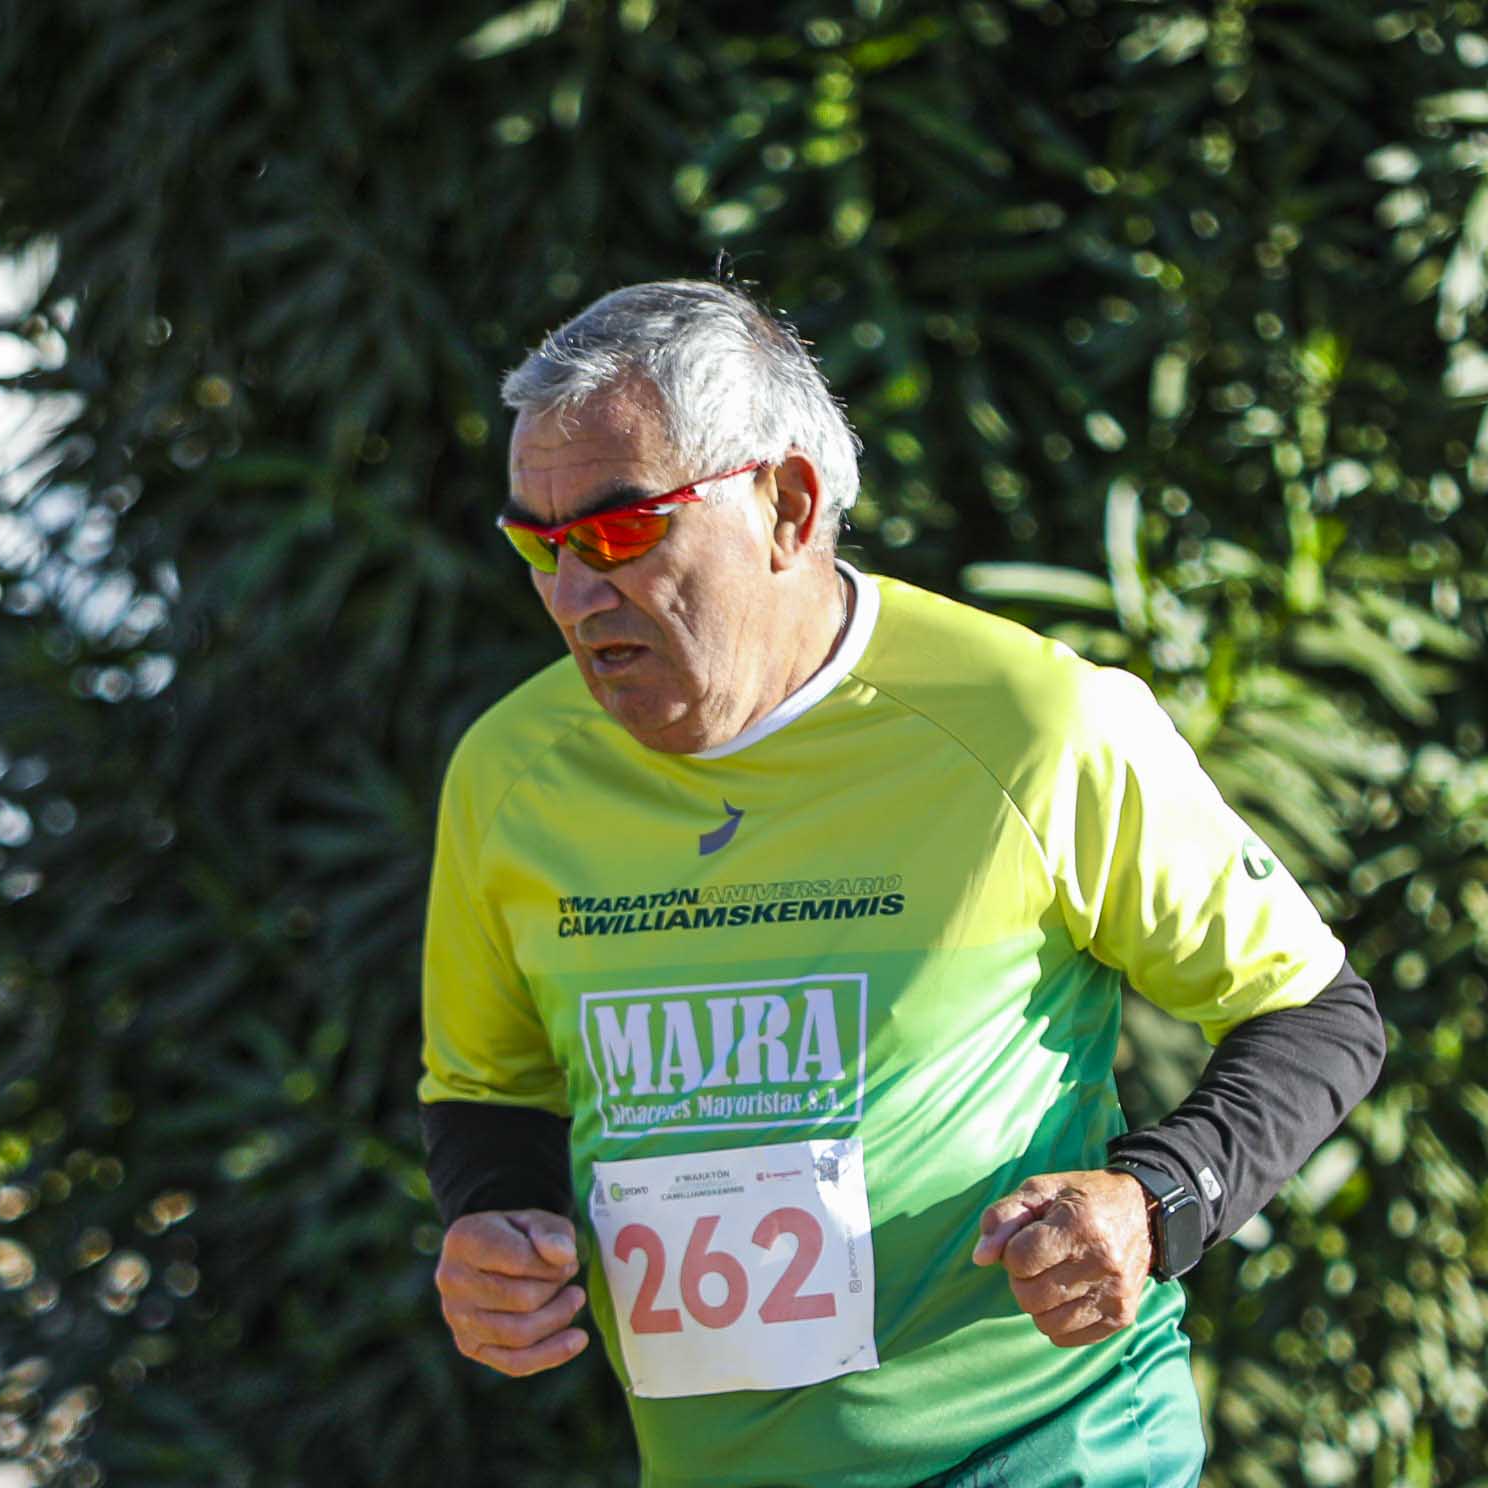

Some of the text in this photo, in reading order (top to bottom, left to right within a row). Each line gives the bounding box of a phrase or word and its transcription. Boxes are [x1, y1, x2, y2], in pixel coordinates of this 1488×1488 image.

[700, 873, 903, 903] ANIVERSARIO
[594, 988, 846, 1096] MAIRA
[698, 1091, 802, 1119] Mayoristas
[613, 1206, 837, 1335] 262
